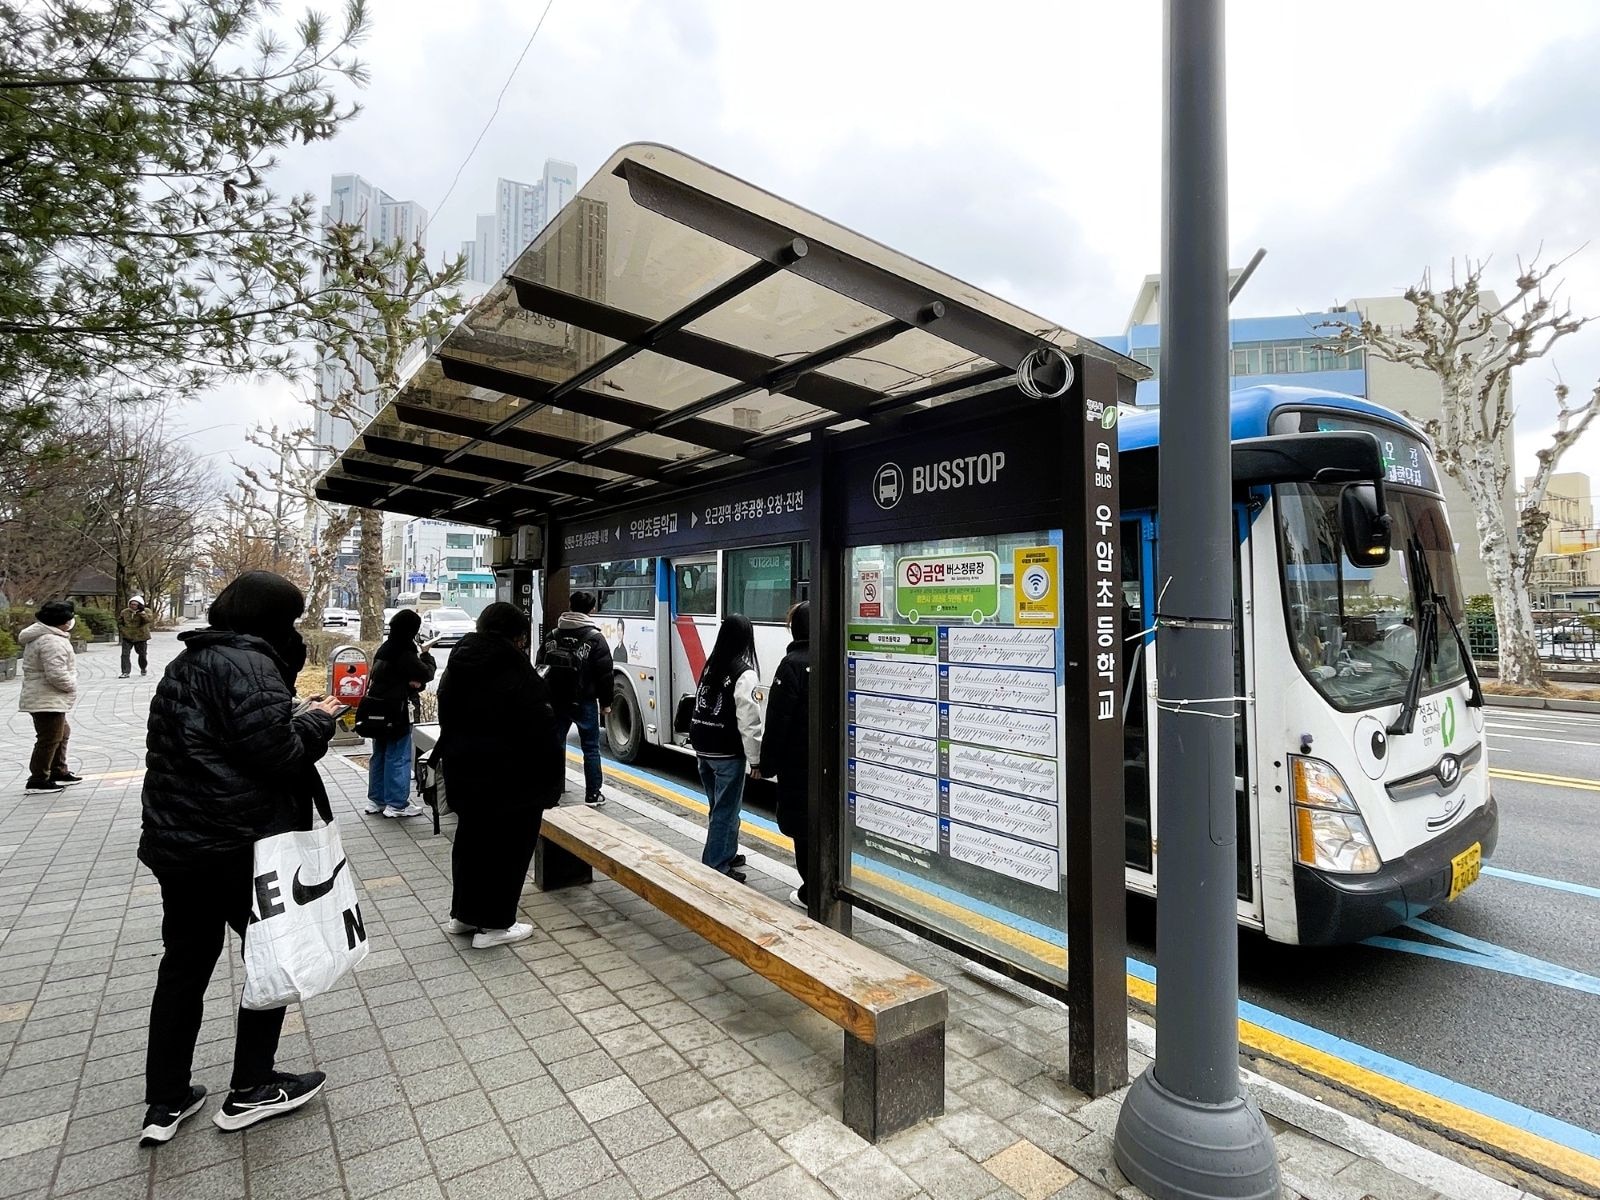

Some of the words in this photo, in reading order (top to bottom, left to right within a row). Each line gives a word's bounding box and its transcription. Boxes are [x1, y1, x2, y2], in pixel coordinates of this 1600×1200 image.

[912, 451, 1005, 494] BUSSTOP
[1095, 472, 1112, 488] BUS
[629, 512, 679, 539] 우암초등학교
[922, 563, 945, 583] 금연
[946, 562, 985, 576] 버스정류장
[1095, 504, 1116, 720] 우암초등학교
